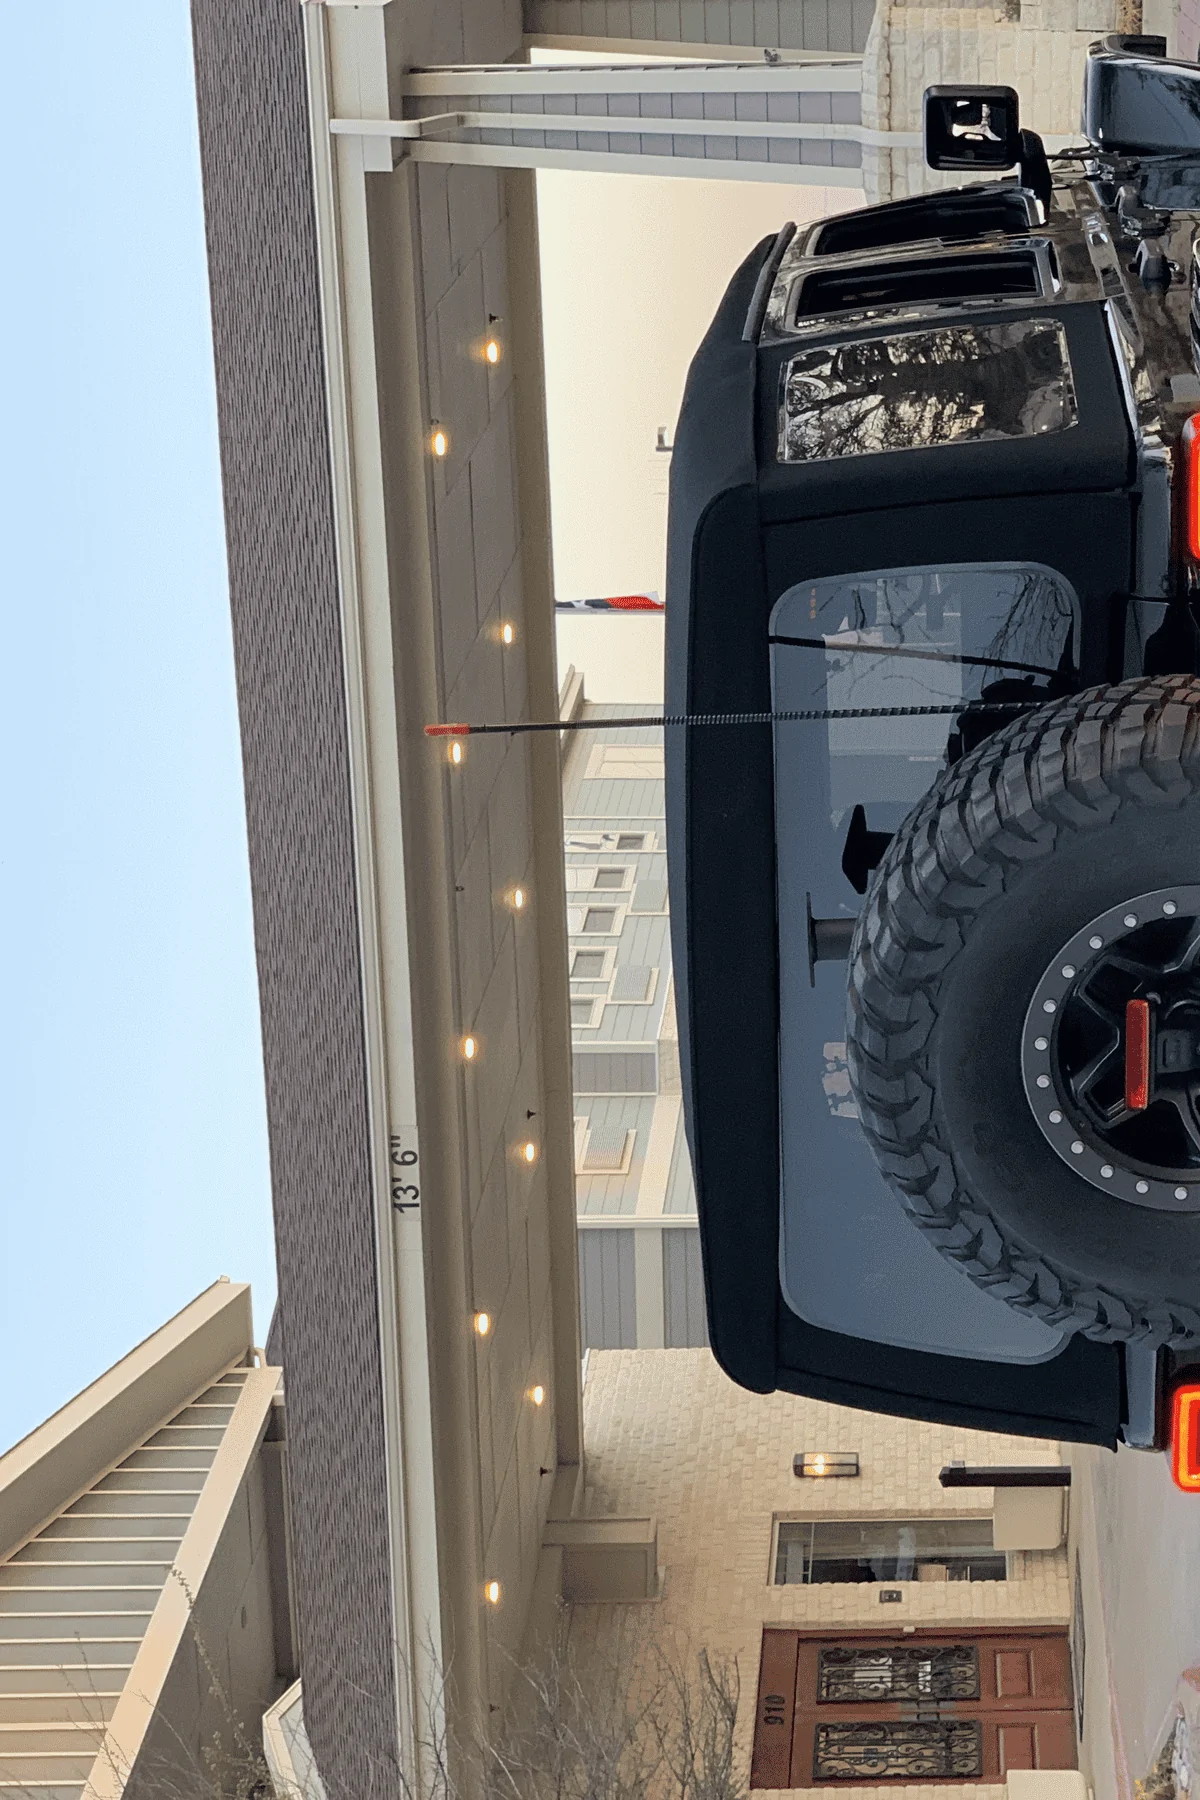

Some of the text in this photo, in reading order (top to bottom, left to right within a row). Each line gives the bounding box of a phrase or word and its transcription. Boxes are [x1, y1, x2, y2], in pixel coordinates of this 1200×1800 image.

[390, 1135, 420, 1214] 13' 6"
[763, 1694, 785, 1725] 910
